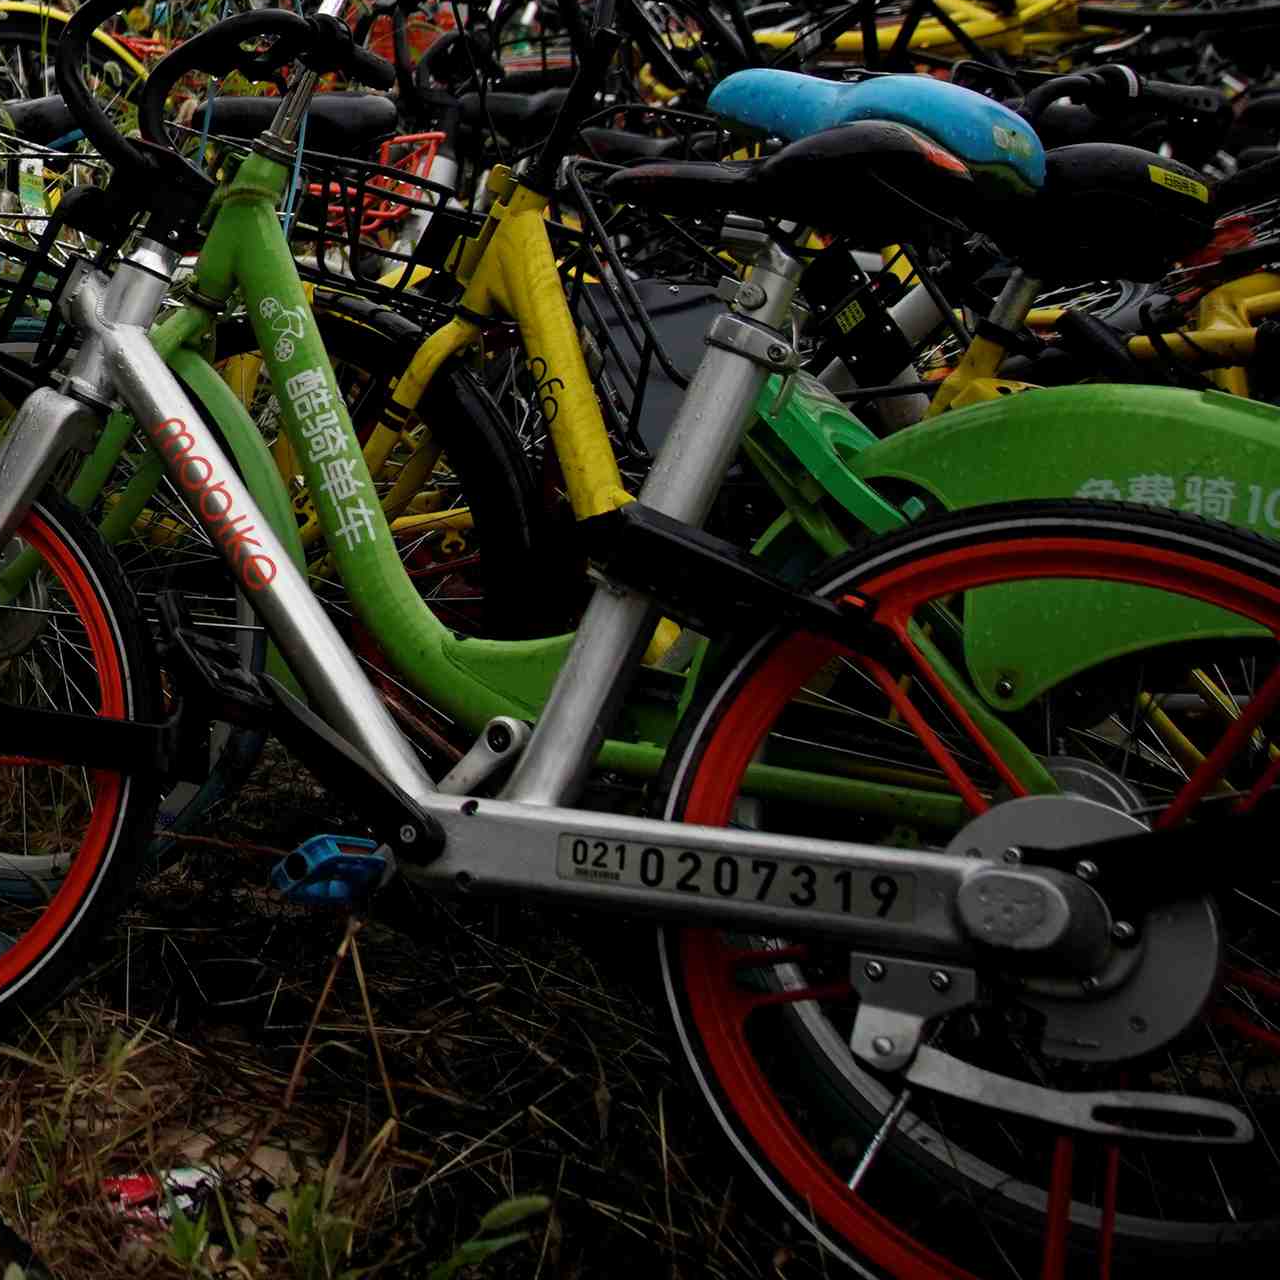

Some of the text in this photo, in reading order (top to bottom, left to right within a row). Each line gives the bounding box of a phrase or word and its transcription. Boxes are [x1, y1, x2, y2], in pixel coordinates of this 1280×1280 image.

[151, 418, 278, 591] mobike
[285, 367, 377, 552] 酷骑单车
[572, 839, 898, 917] 021 0207319
